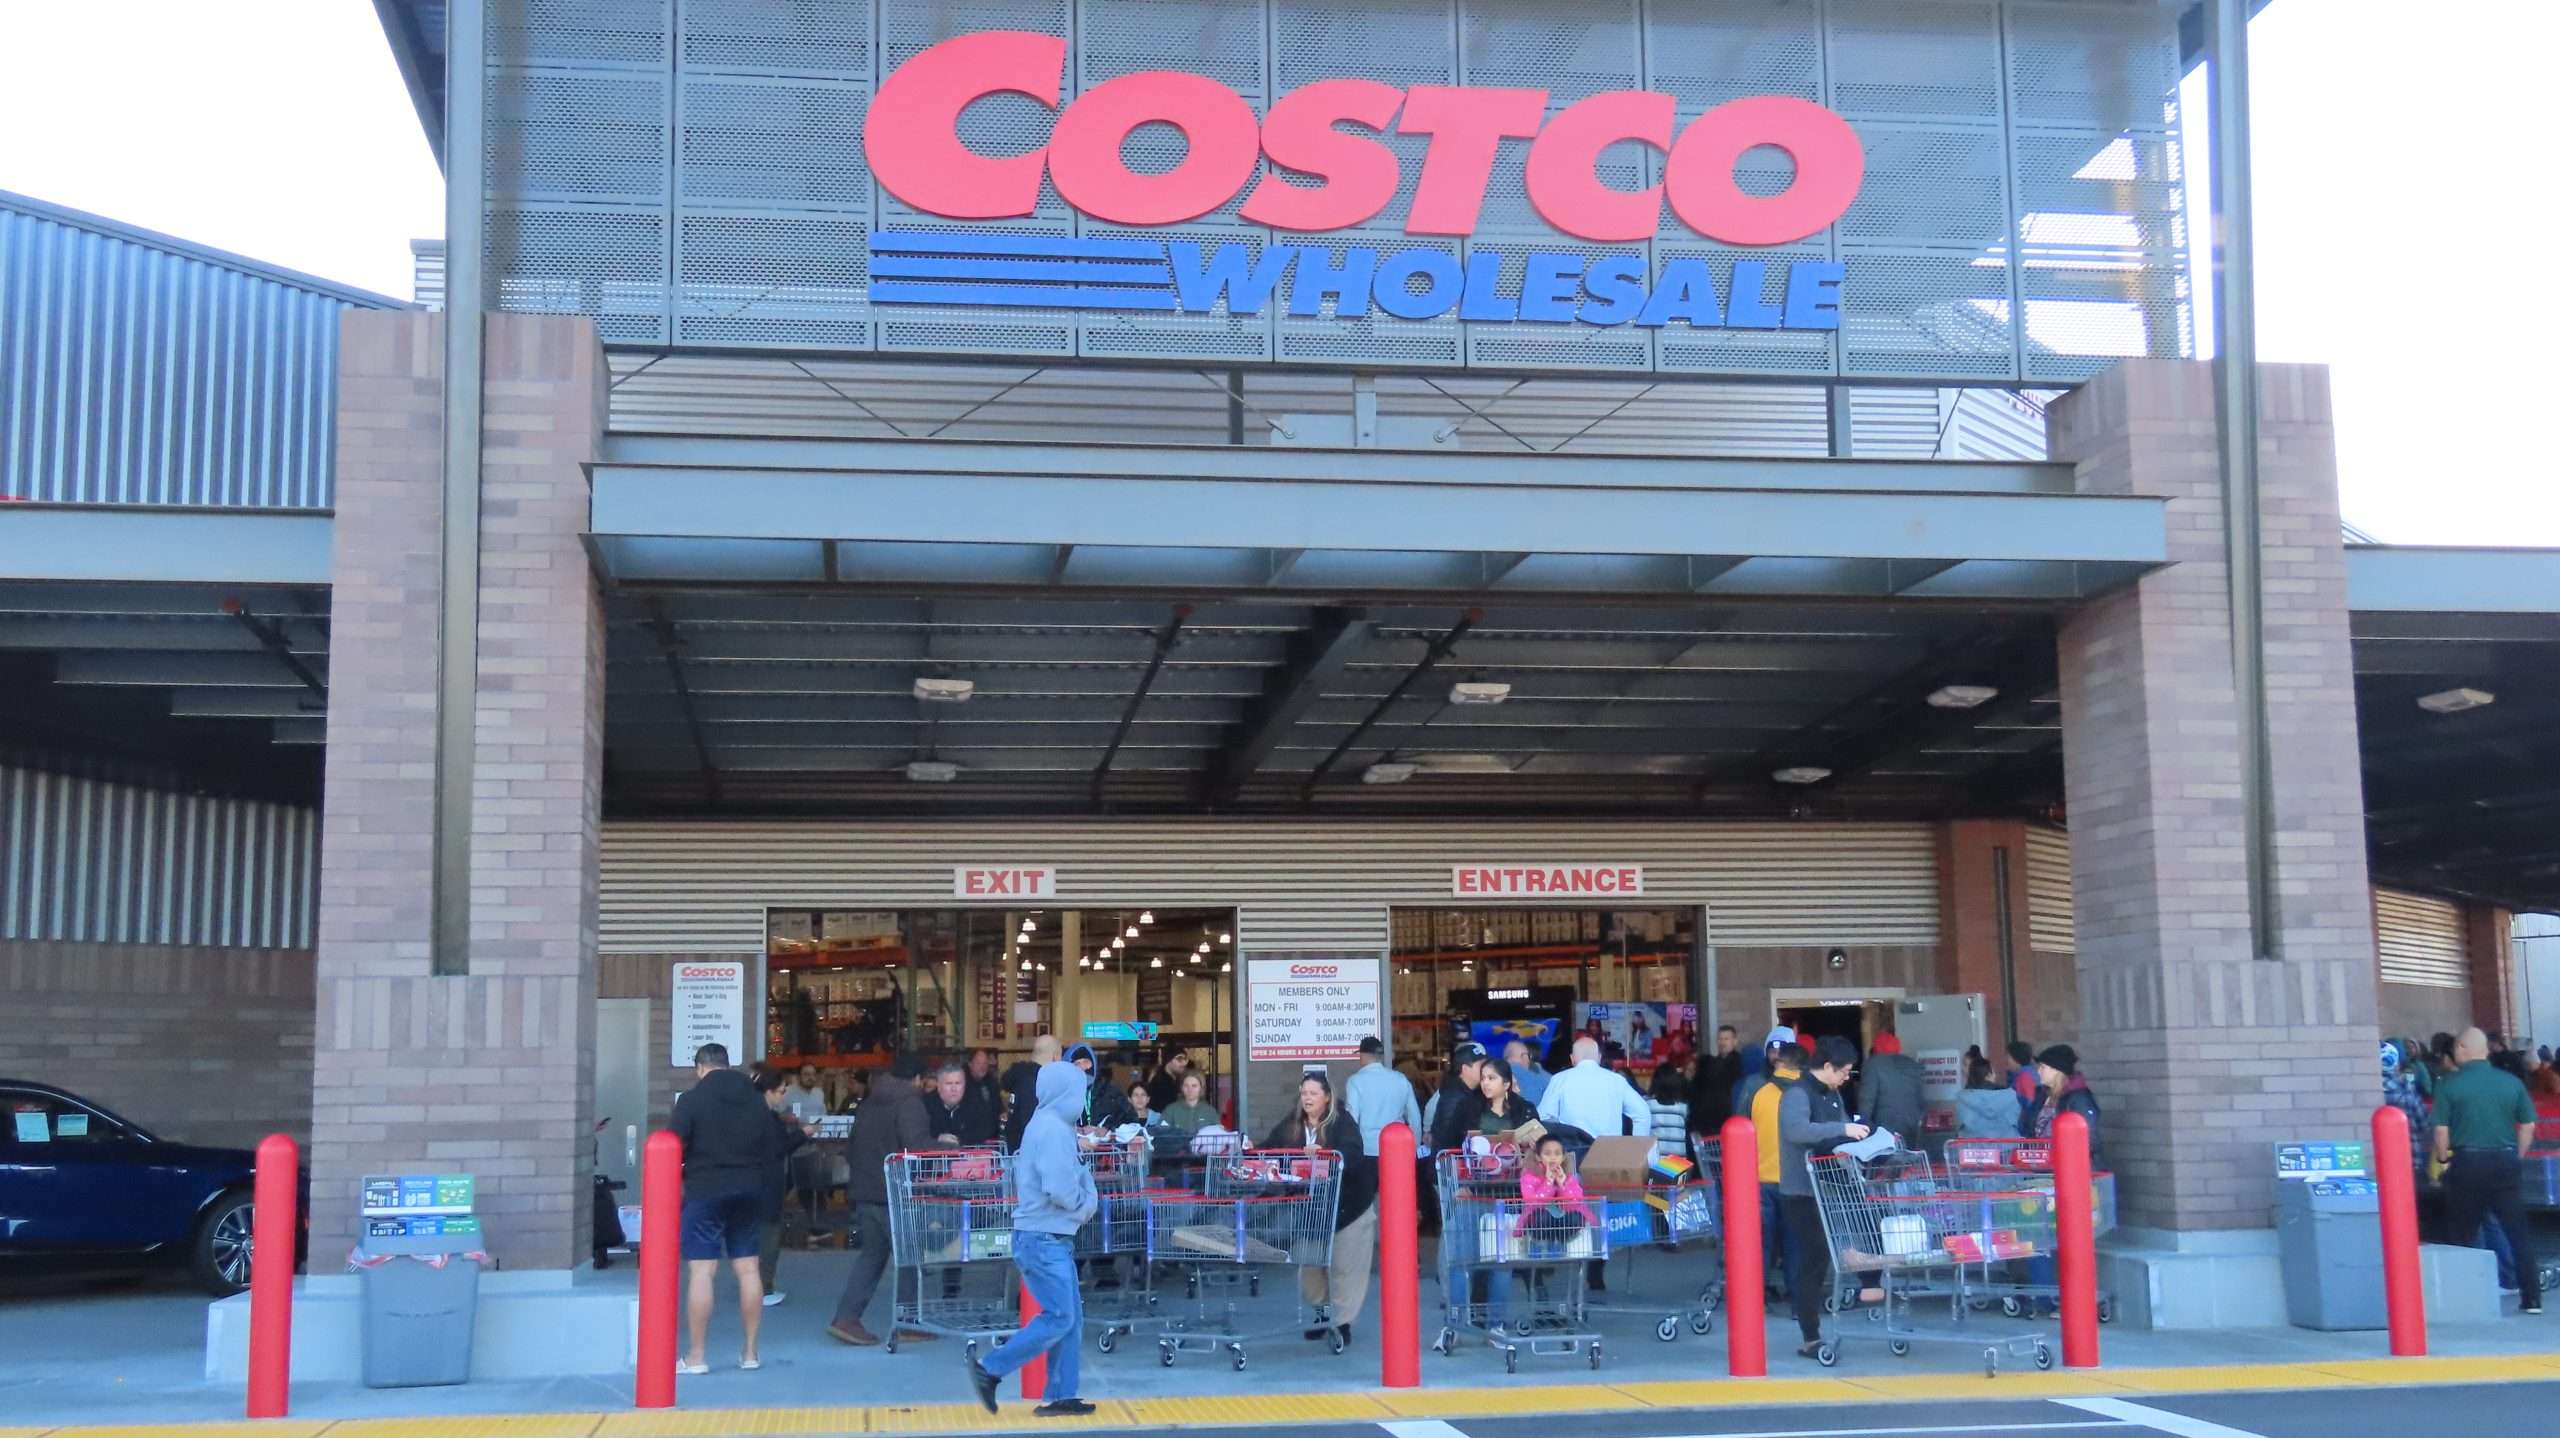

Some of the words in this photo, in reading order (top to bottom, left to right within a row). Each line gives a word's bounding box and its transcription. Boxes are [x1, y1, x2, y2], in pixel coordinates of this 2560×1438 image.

[863, 31, 1865, 246] COSTCO
[1168, 242, 1846, 330] WHOLESALE
[966, 871, 1044, 893] EXIT
[1459, 869, 1637, 892] ENTRANCE
[682, 967, 736, 976] COSTCO
[1290, 965, 1338, 973] COSTCO
[1278, 987, 1324, 996] MEMBERS
[1326, 987, 1350, 996] ONLY
[1488, 990, 1529, 999] SAMSUNG
[1255, 1003, 1275, 1012] MON
[1284, 1003, 1298, 1012] FRI
[1255, 1018, 1302, 1027] SATURDAY
[1255, 1034, 1291, 1043] SUNDAY
